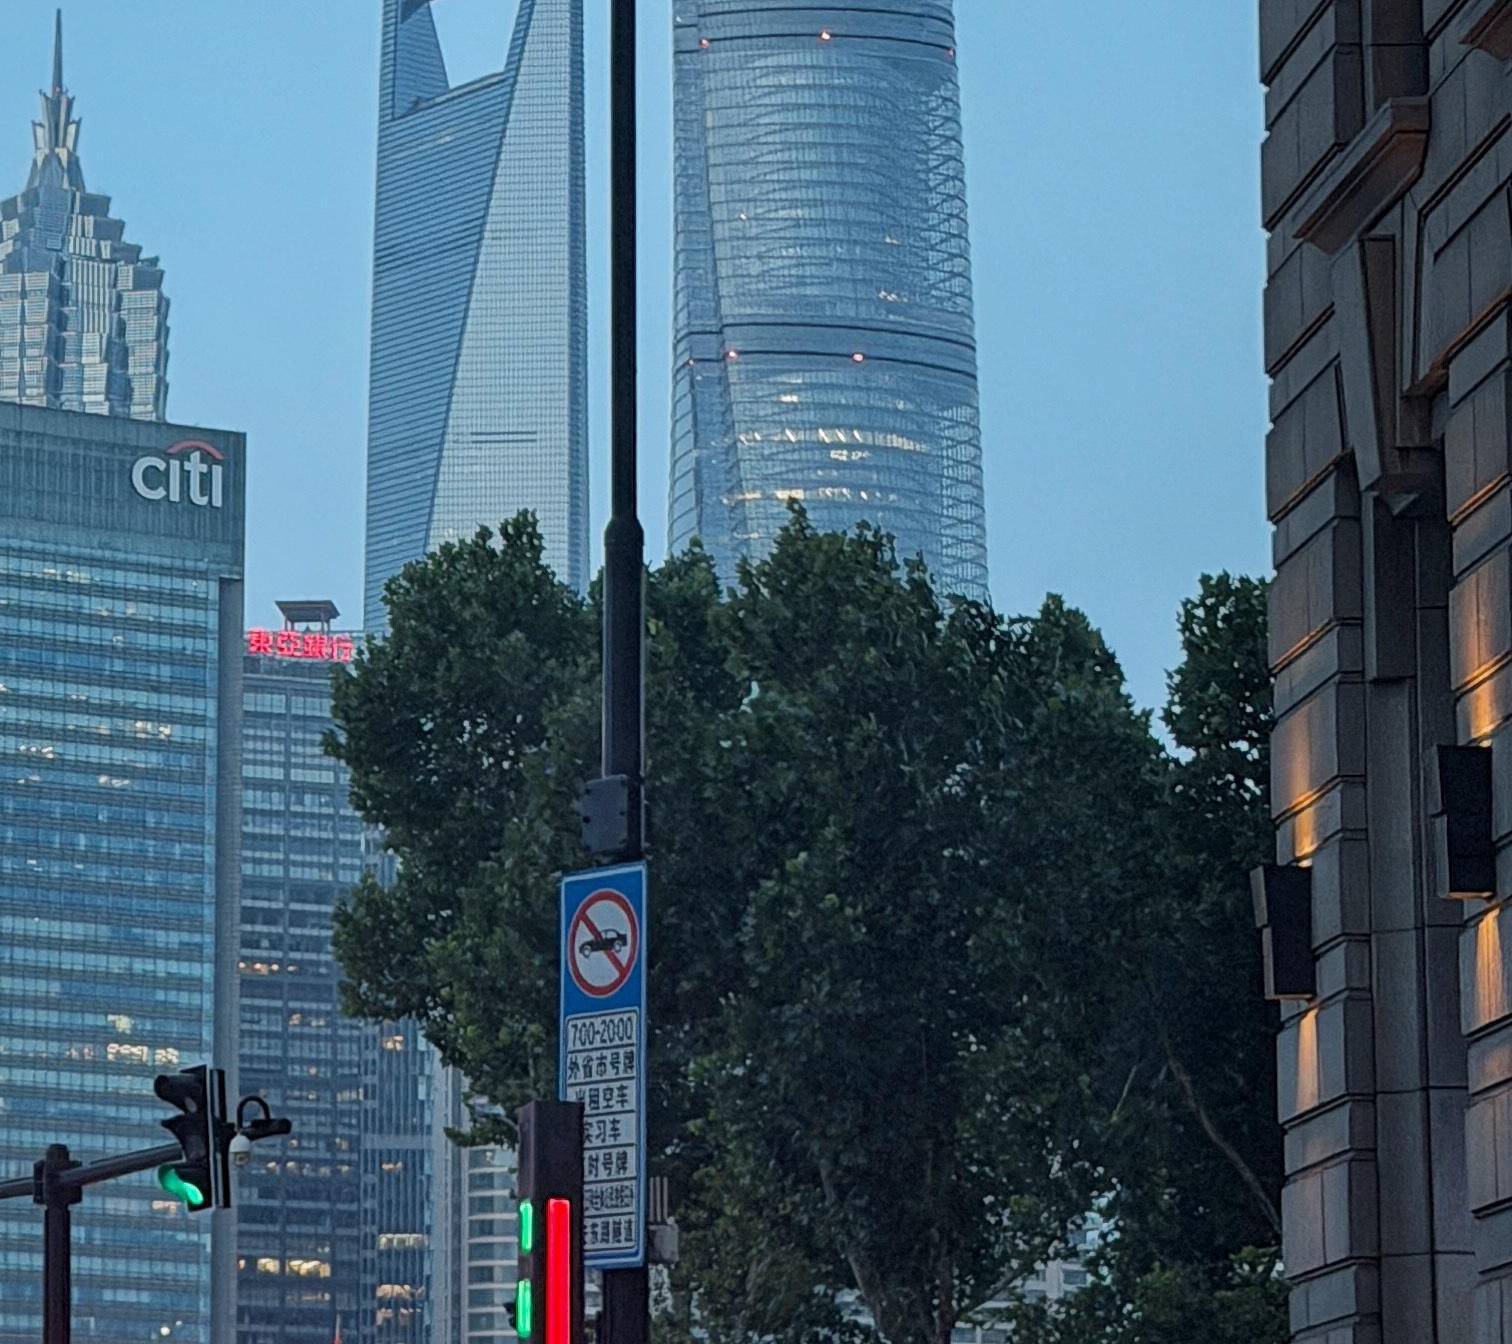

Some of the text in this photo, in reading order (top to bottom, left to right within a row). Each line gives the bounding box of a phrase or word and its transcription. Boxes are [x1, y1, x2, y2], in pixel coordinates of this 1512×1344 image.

[131, 448, 223, 508] citi
[248, 627, 353, 662] 東亞銀行
[569, 1051, 634, 1080] 外省市号牌
[584, 1150, 628, 1178] 时号牌
